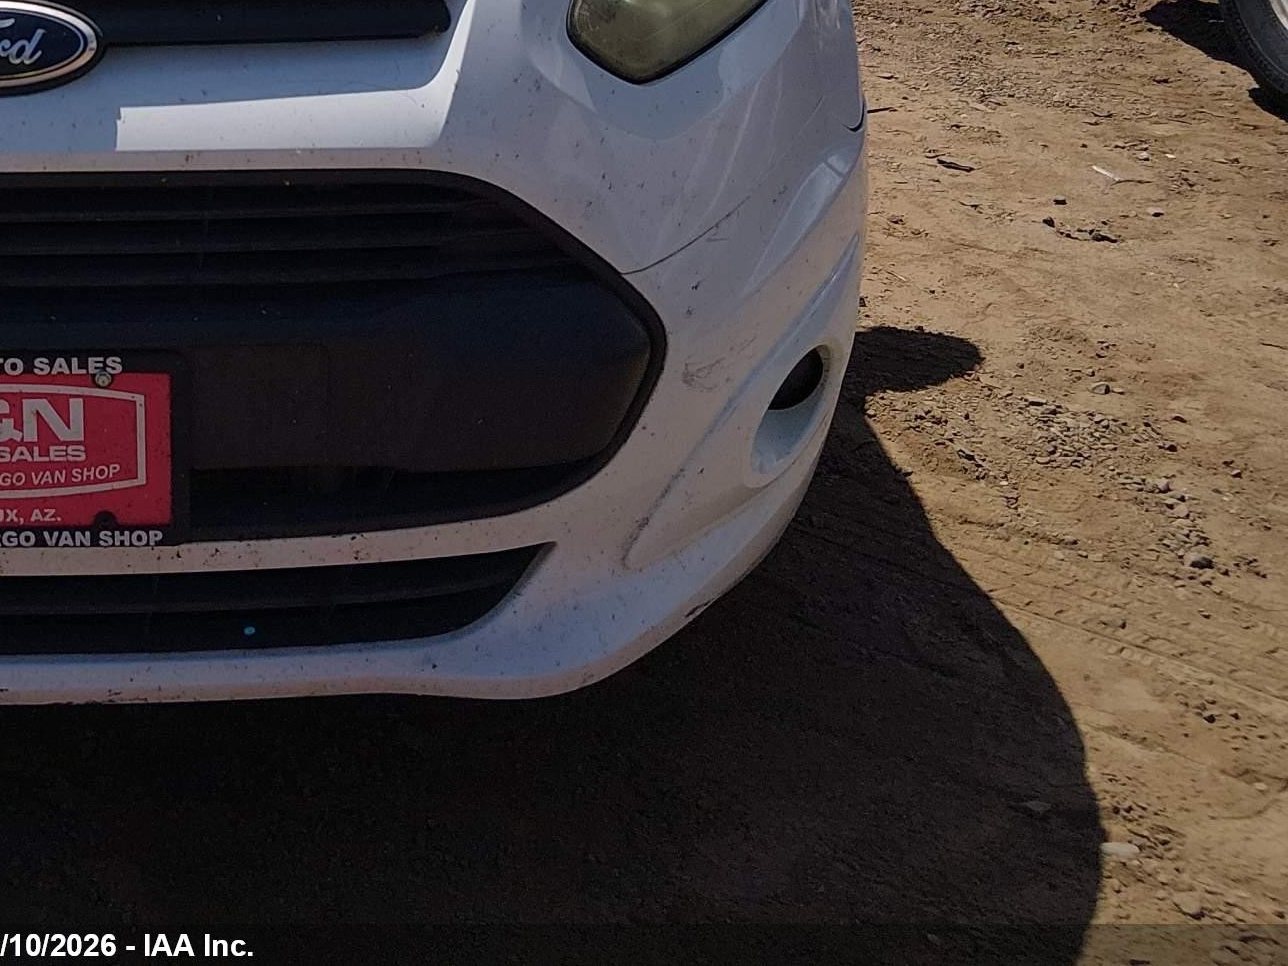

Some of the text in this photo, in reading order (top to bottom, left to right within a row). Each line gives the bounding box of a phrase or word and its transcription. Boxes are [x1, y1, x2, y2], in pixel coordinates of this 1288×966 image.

[33, 356, 123, 375] SALES
[31, 469, 66, 484] VAN
[71, 463, 121, 482] SHOP
[30, 508, 62, 523] AZ.
[43, 531, 91, 547] VAN
[98, 530, 163, 547] SHOP
